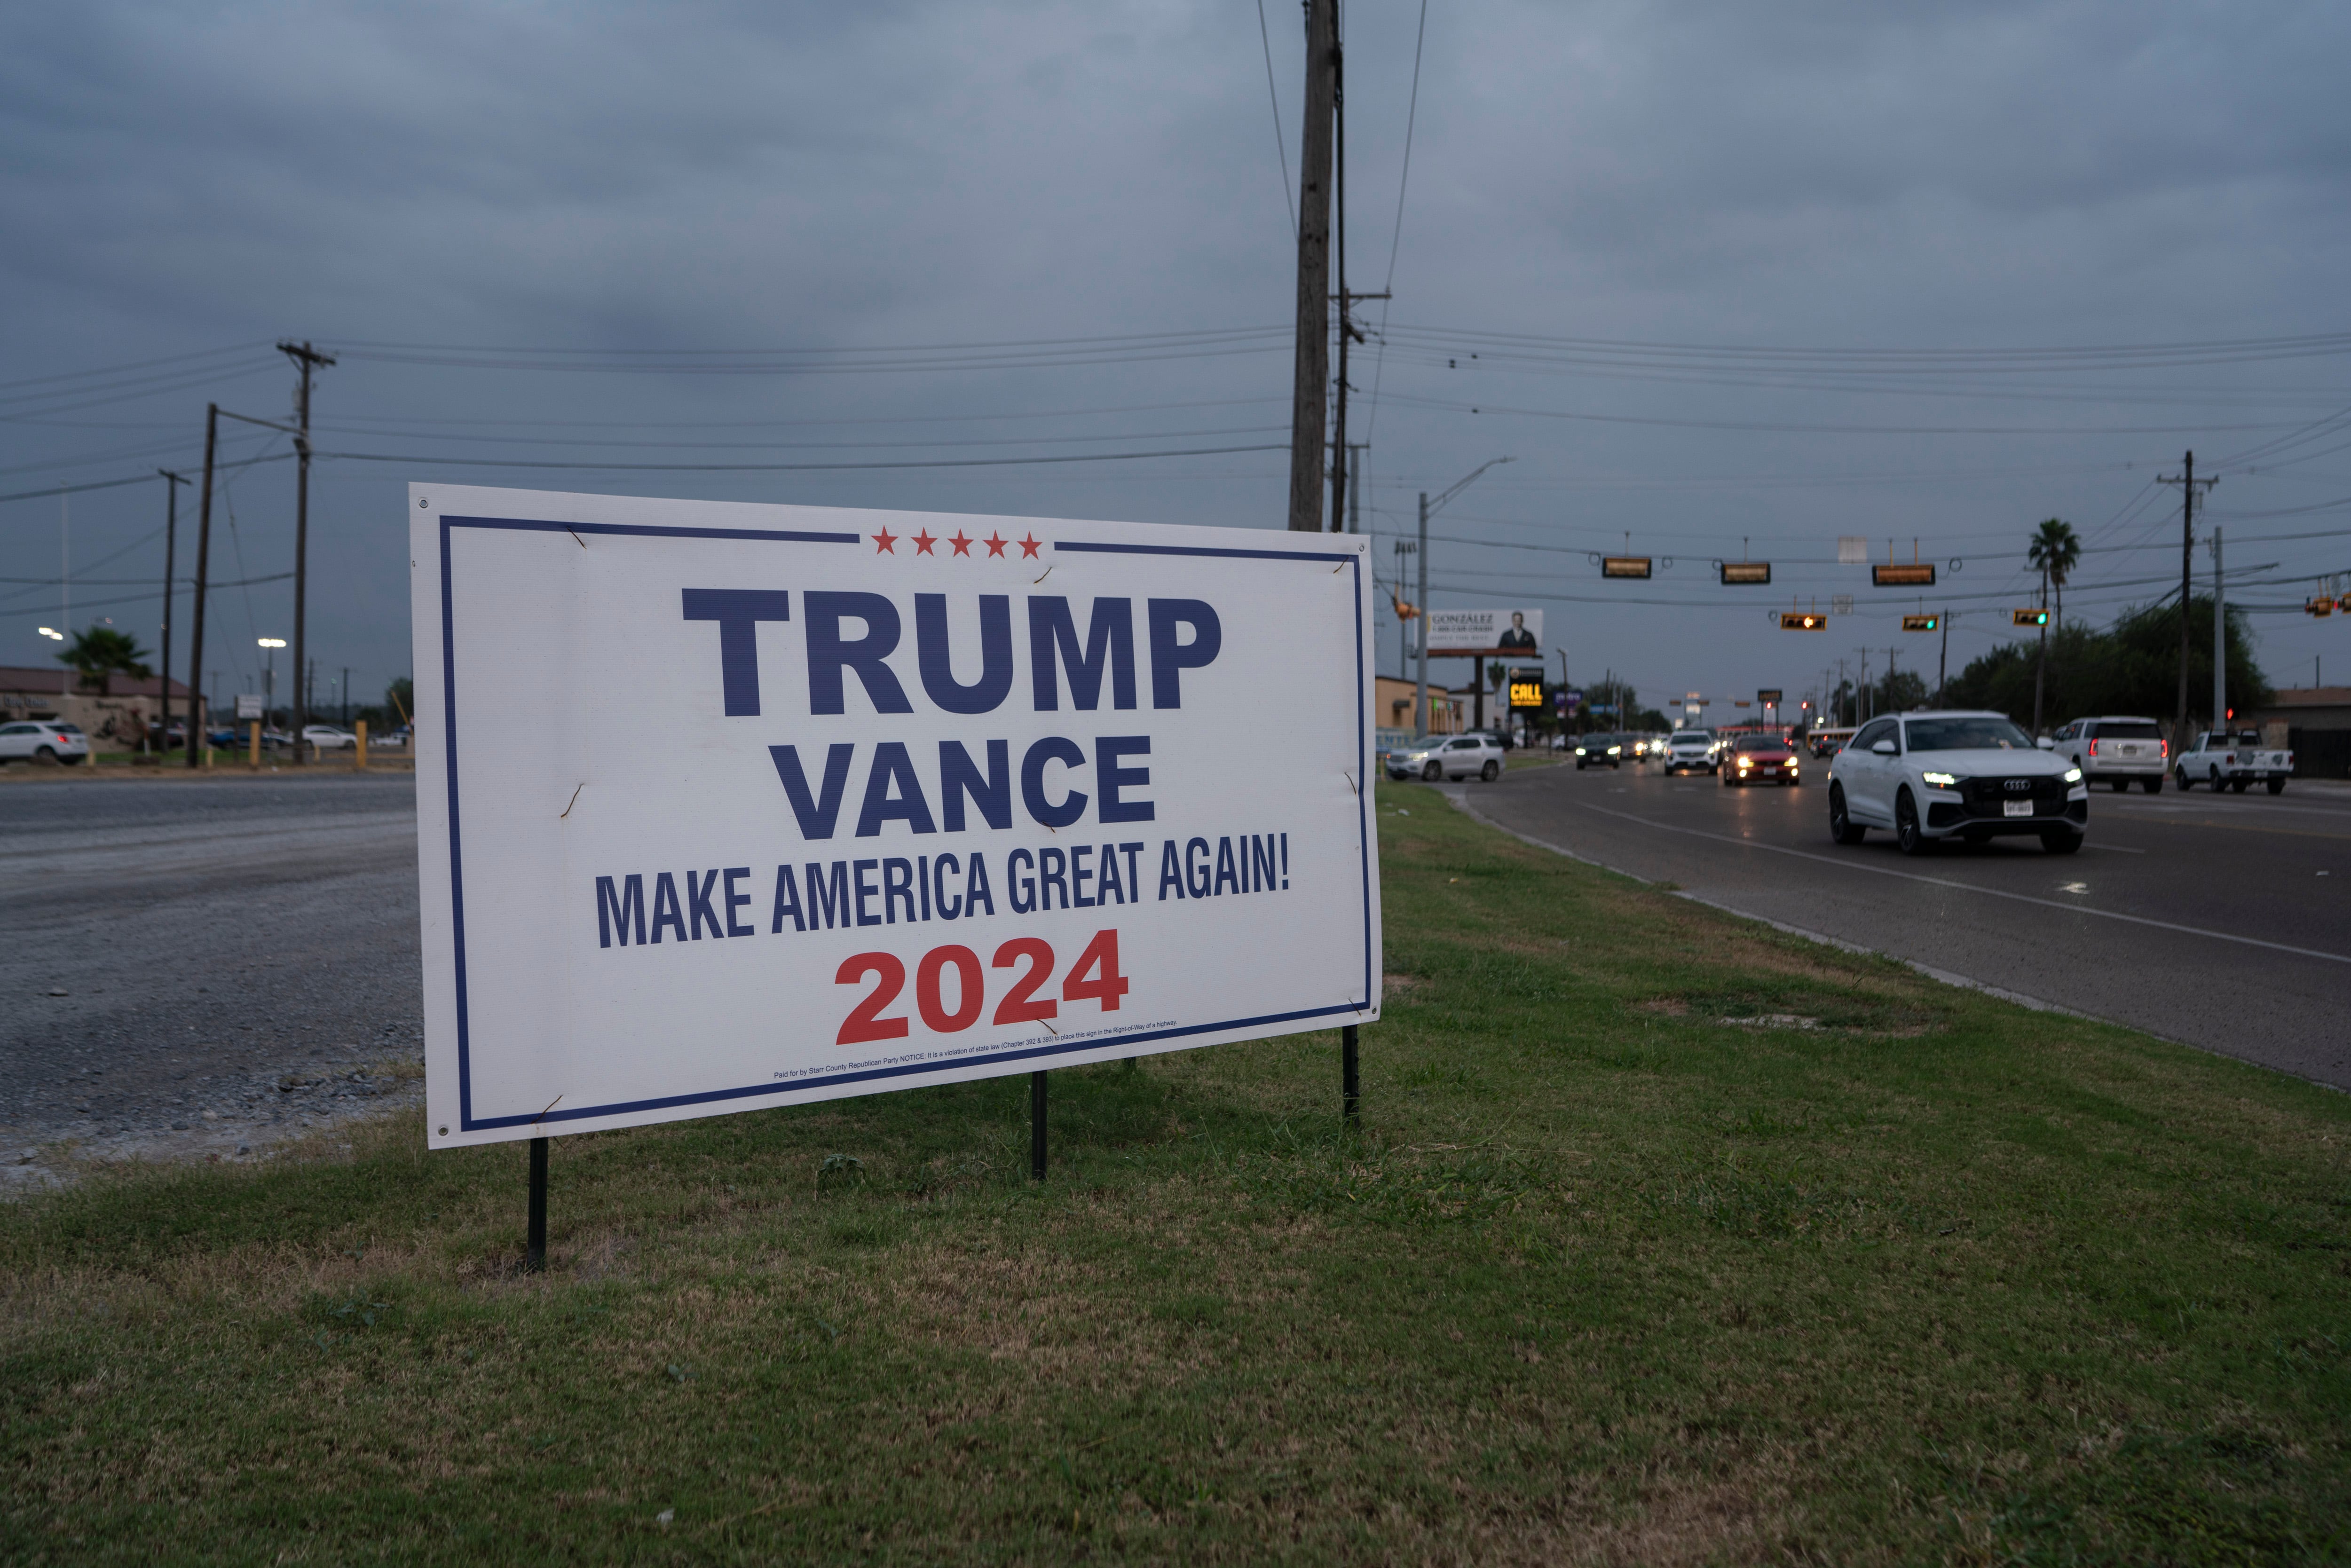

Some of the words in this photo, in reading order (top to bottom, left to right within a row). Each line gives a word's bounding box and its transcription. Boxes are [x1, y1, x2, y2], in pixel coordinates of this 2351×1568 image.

[682, 588, 1221, 717] TRUMP
[1432, 611, 1493, 624] GONZÁLEZ
[1510, 683, 1543, 700] CALL
[768, 736, 1155, 840] VANCE
[596, 867, 754, 948] MAKE
[772, 852, 995, 934] AMERICA
[1008, 842, 1144, 914] GREAT
[1159, 833, 1289, 900] AGAIN!
[835, 929, 1128, 1045] 2024
[849, 1060, 881, 1069] Republican
[900, 1053, 926, 1062] NOTICE:
[1001, 1041, 1025, 1049] (Chapter
[1113, 1024, 1145, 1033] Right-of-Way
